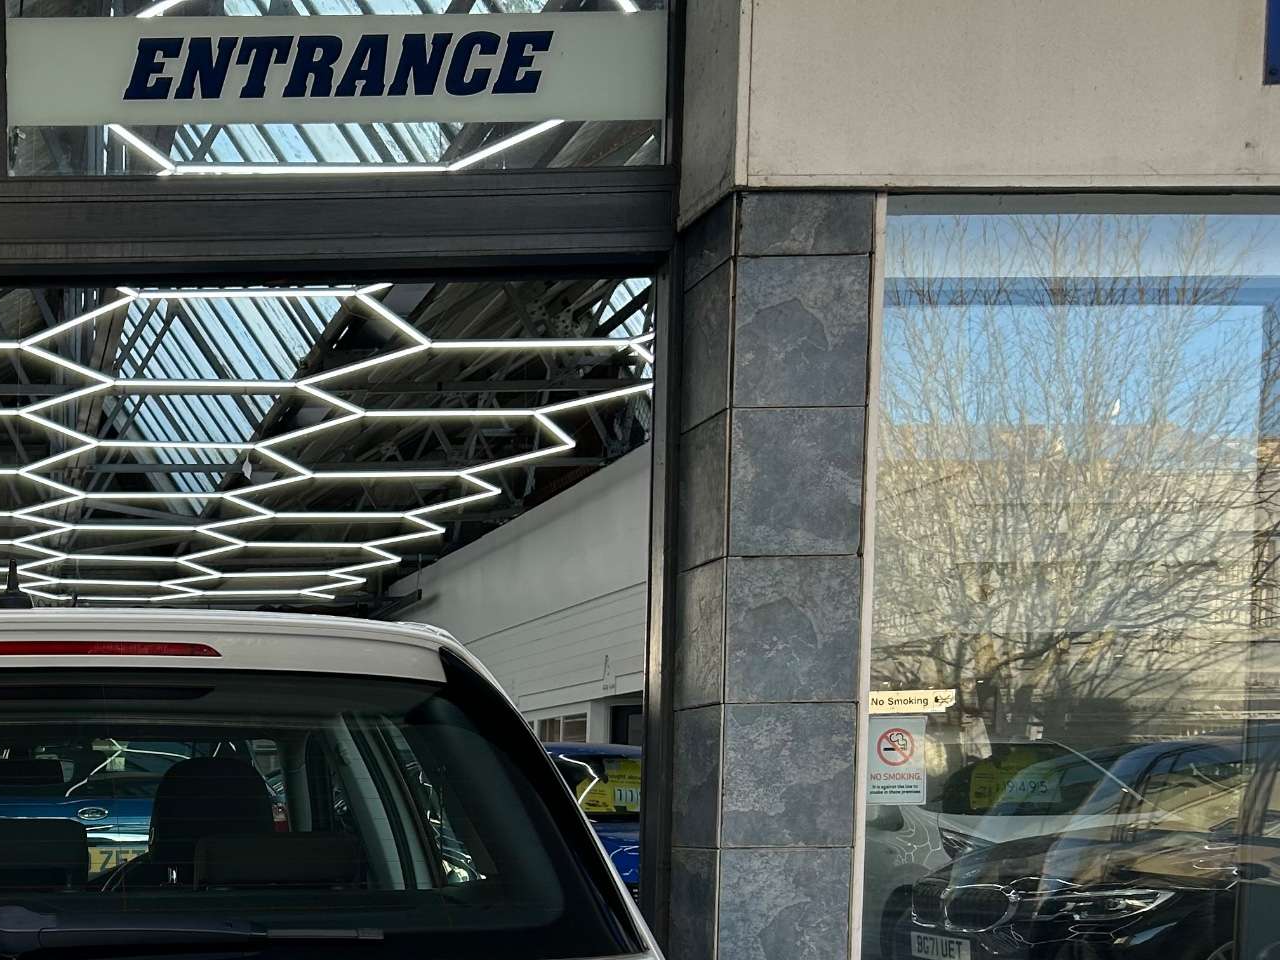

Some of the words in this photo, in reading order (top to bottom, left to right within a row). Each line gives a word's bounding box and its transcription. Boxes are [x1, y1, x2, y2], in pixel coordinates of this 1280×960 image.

[122, 31, 554, 100] ENTRANCE
[871, 698, 885, 706] No
[888, 697, 929, 706] Smoking
[870, 772, 882, 781] NO
[940, 938, 963, 960] UET
